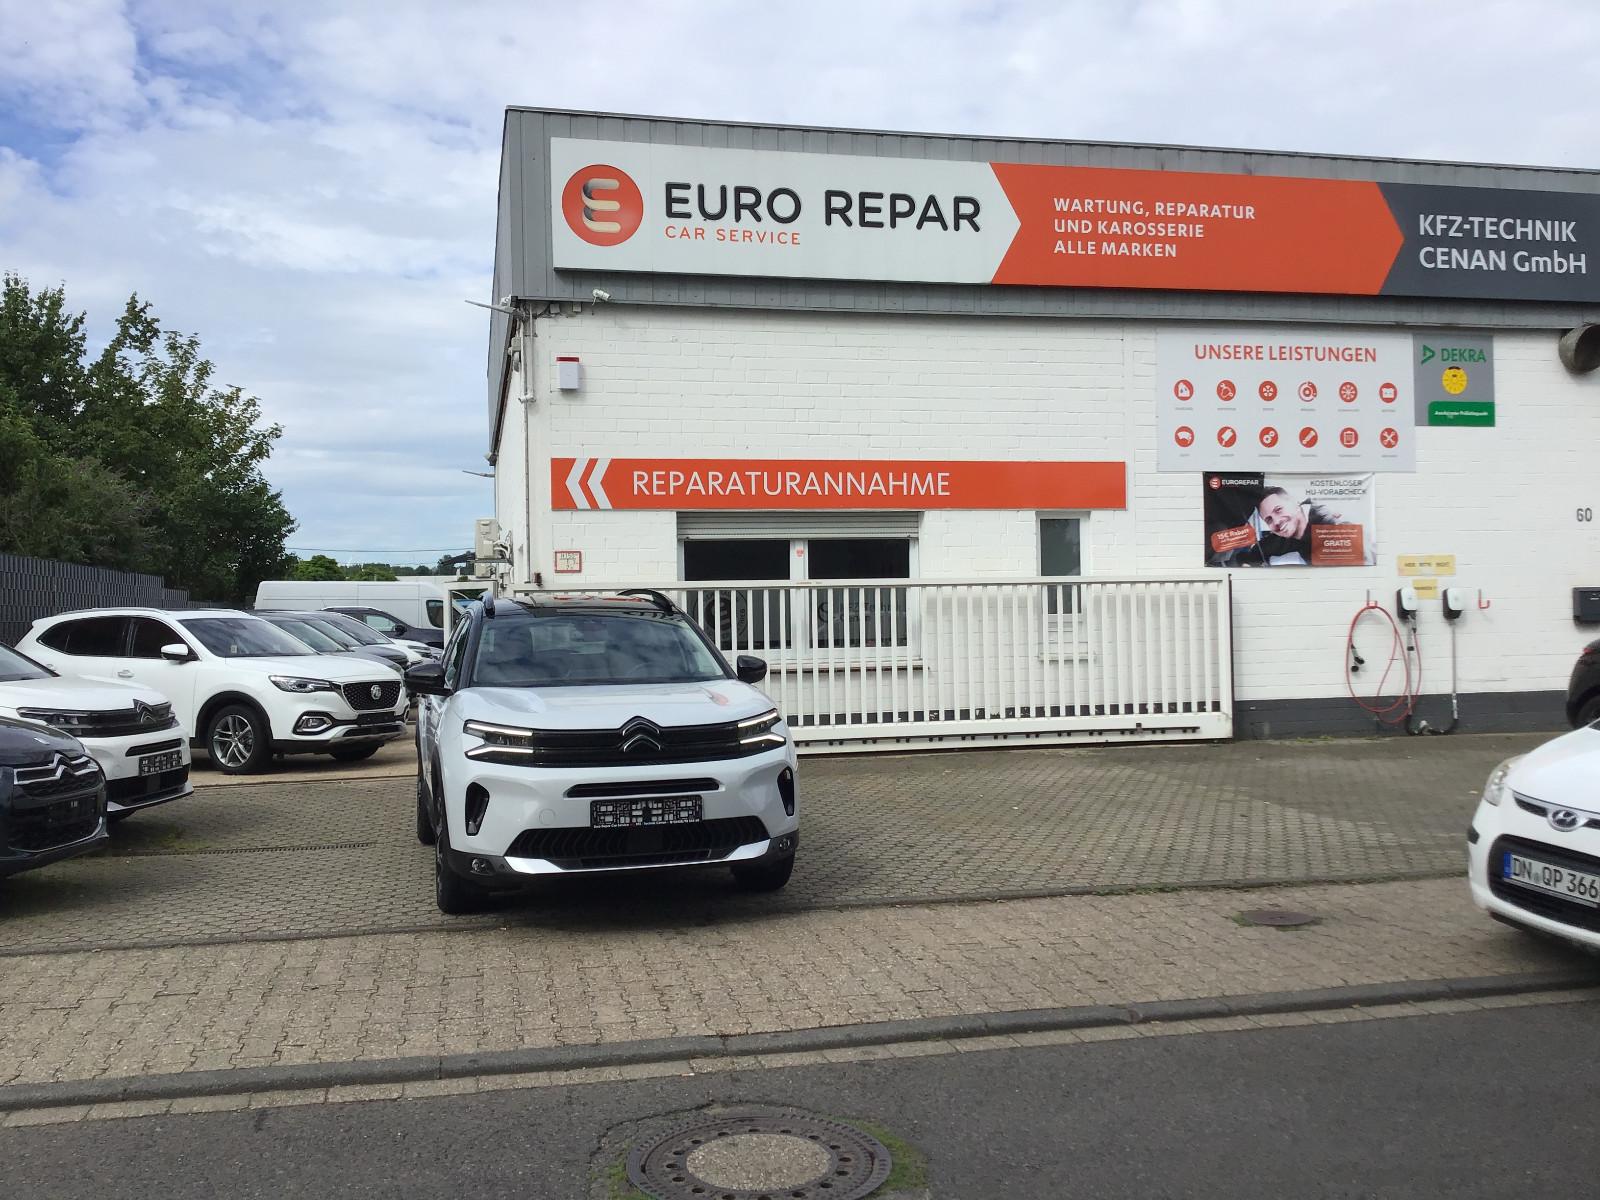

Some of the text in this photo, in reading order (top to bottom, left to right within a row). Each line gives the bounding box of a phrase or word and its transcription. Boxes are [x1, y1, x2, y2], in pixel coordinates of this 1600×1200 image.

[665, 181, 980, 233] EURO REPAR
[1053, 197, 1255, 219] WARTUNG, REPARATUR
[665, 225, 801, 245] CAR SERVICE
[1054, 219, 1204, 237] UND KAROSSERIE
[1418, 213, 1576, 242] KFZ-TECHNIK
[1053, 240, 1177, 258] ALLE MARKEN
[1419, 246, 1586, 274] CENAN GmbH
[1195, 344, 1377, 363] UNSERE LEISTUNGEN
[1441, 347, 1487, 363] DEKRA
[632, 470, 951, 497] REPARATURANNAHME
[1305, 488, 1367, 496] HU-VORABCHECK
[1310, 479, 1362, 487] KOSTENLOSER
[1576, 507, 1593, 523] 60
[1323, 539, 1352, 547] GRATIS
[1513, 857, 1533, 881] DN
[1542, 866, 1564, 889] QP
